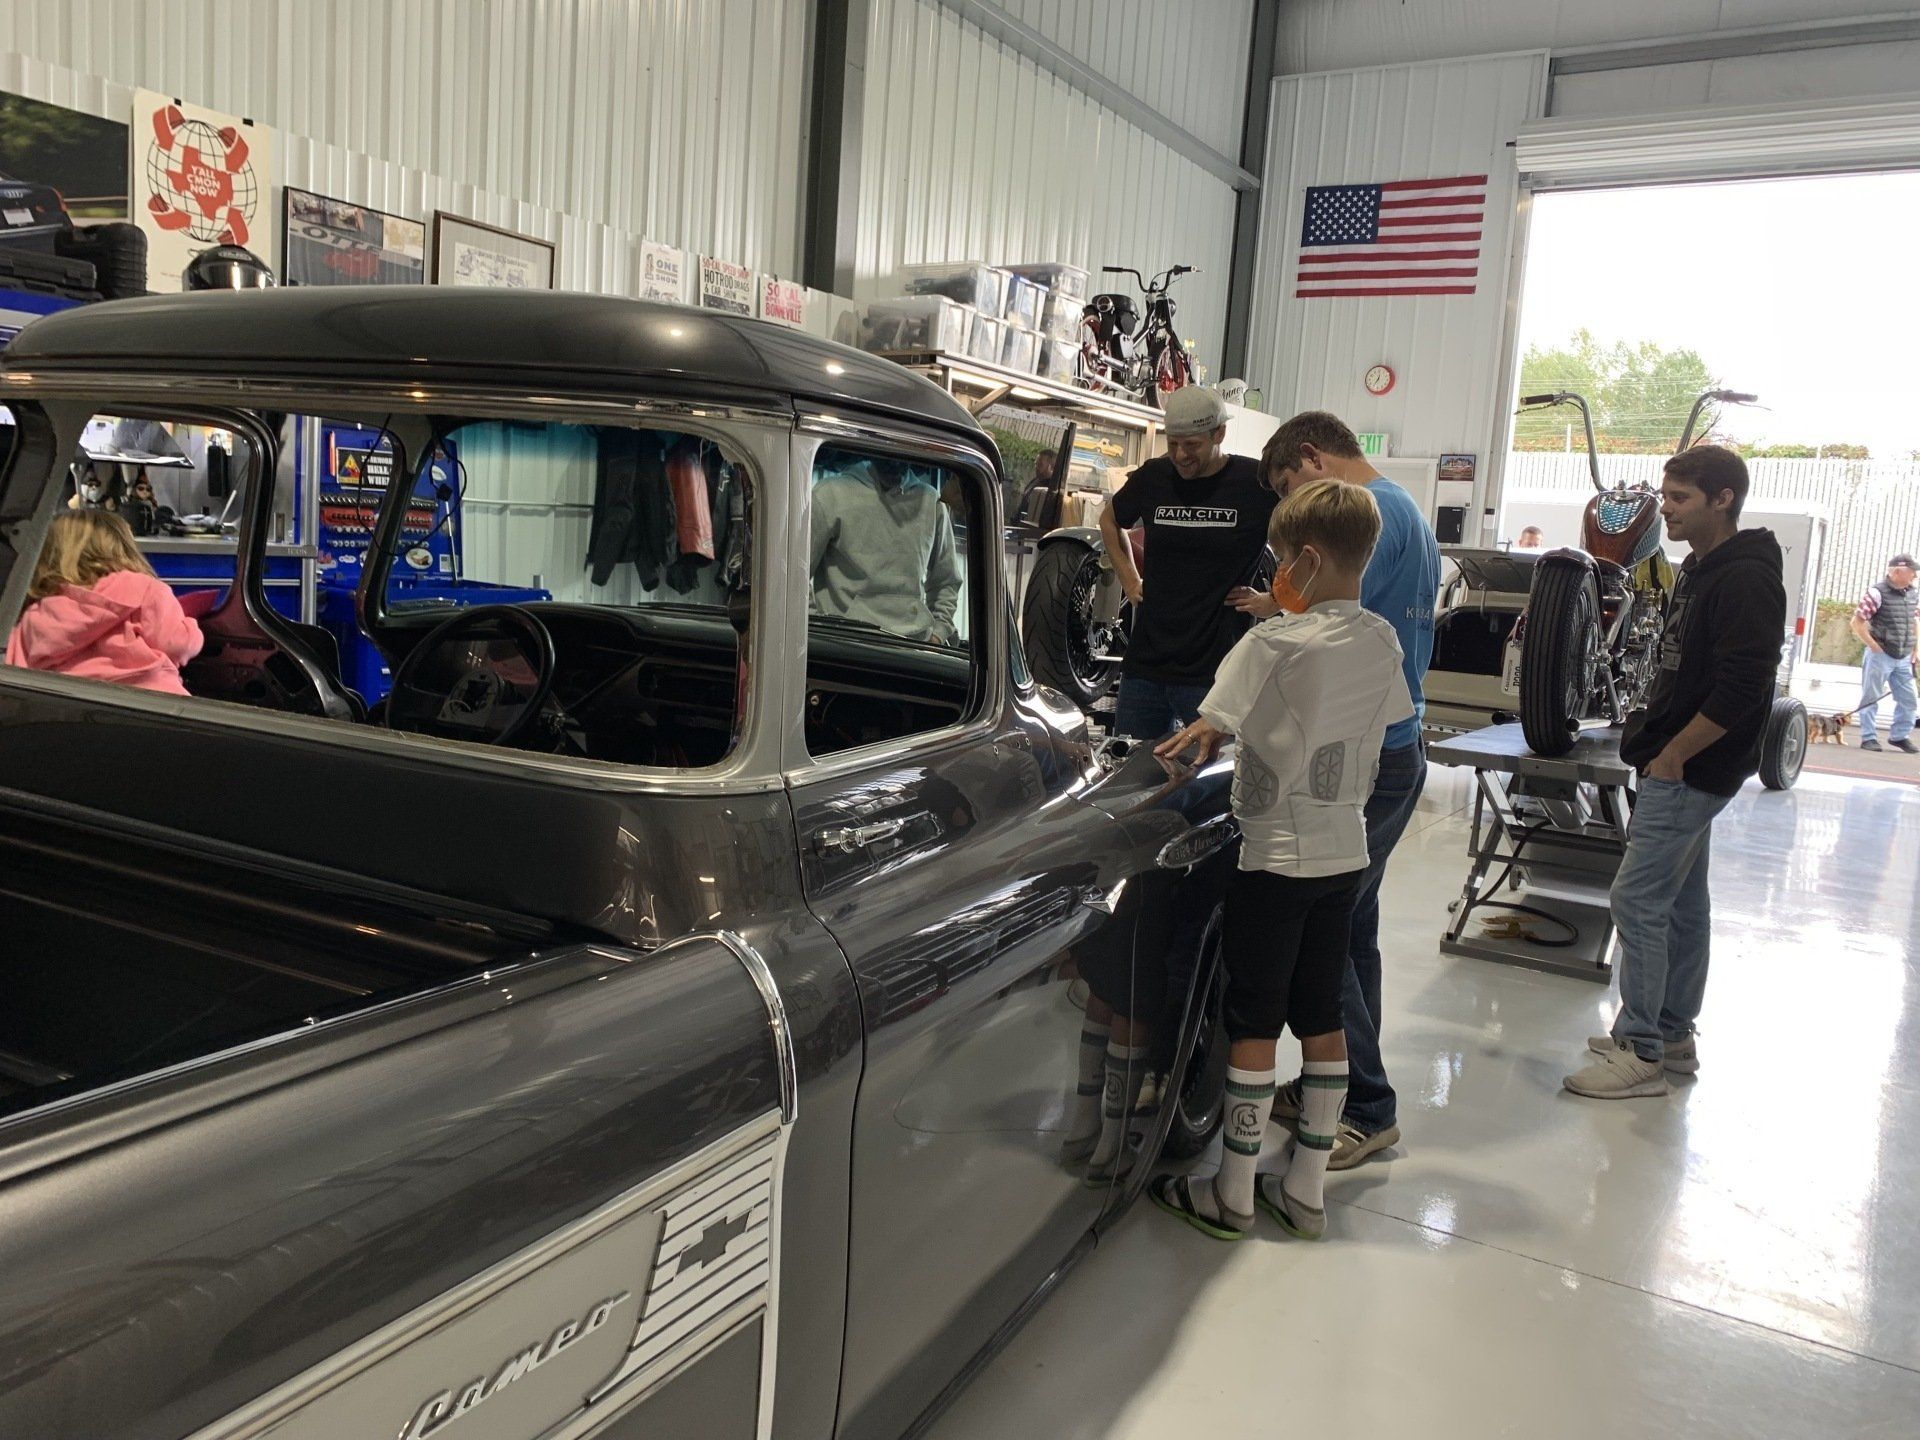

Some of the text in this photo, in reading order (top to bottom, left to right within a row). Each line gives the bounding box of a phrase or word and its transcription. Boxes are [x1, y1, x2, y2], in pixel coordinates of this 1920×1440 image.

[191, 165, 216, 180] Y'ALL
[186, 173, 221, 190] C'MON
[190, 183, 218, 198] NOW
[656, 259, 679, 273] ONE
[722, 263, 736, 276] SPEED
[655, 274, 678, 285] SHOW
[704, 268, 750, 292] HOTROD DRAGS
[711, 285, 721, 296] CAR
[767, 282, 800, 304] SO CAL
[765, 302, 801, 324] BONNEVILLE
[1358, 434, 1384, 454] EXIT
[1157, 508, 1234, 521] RAIN CITY
[398, 1290, 632, 1440] Cameo
